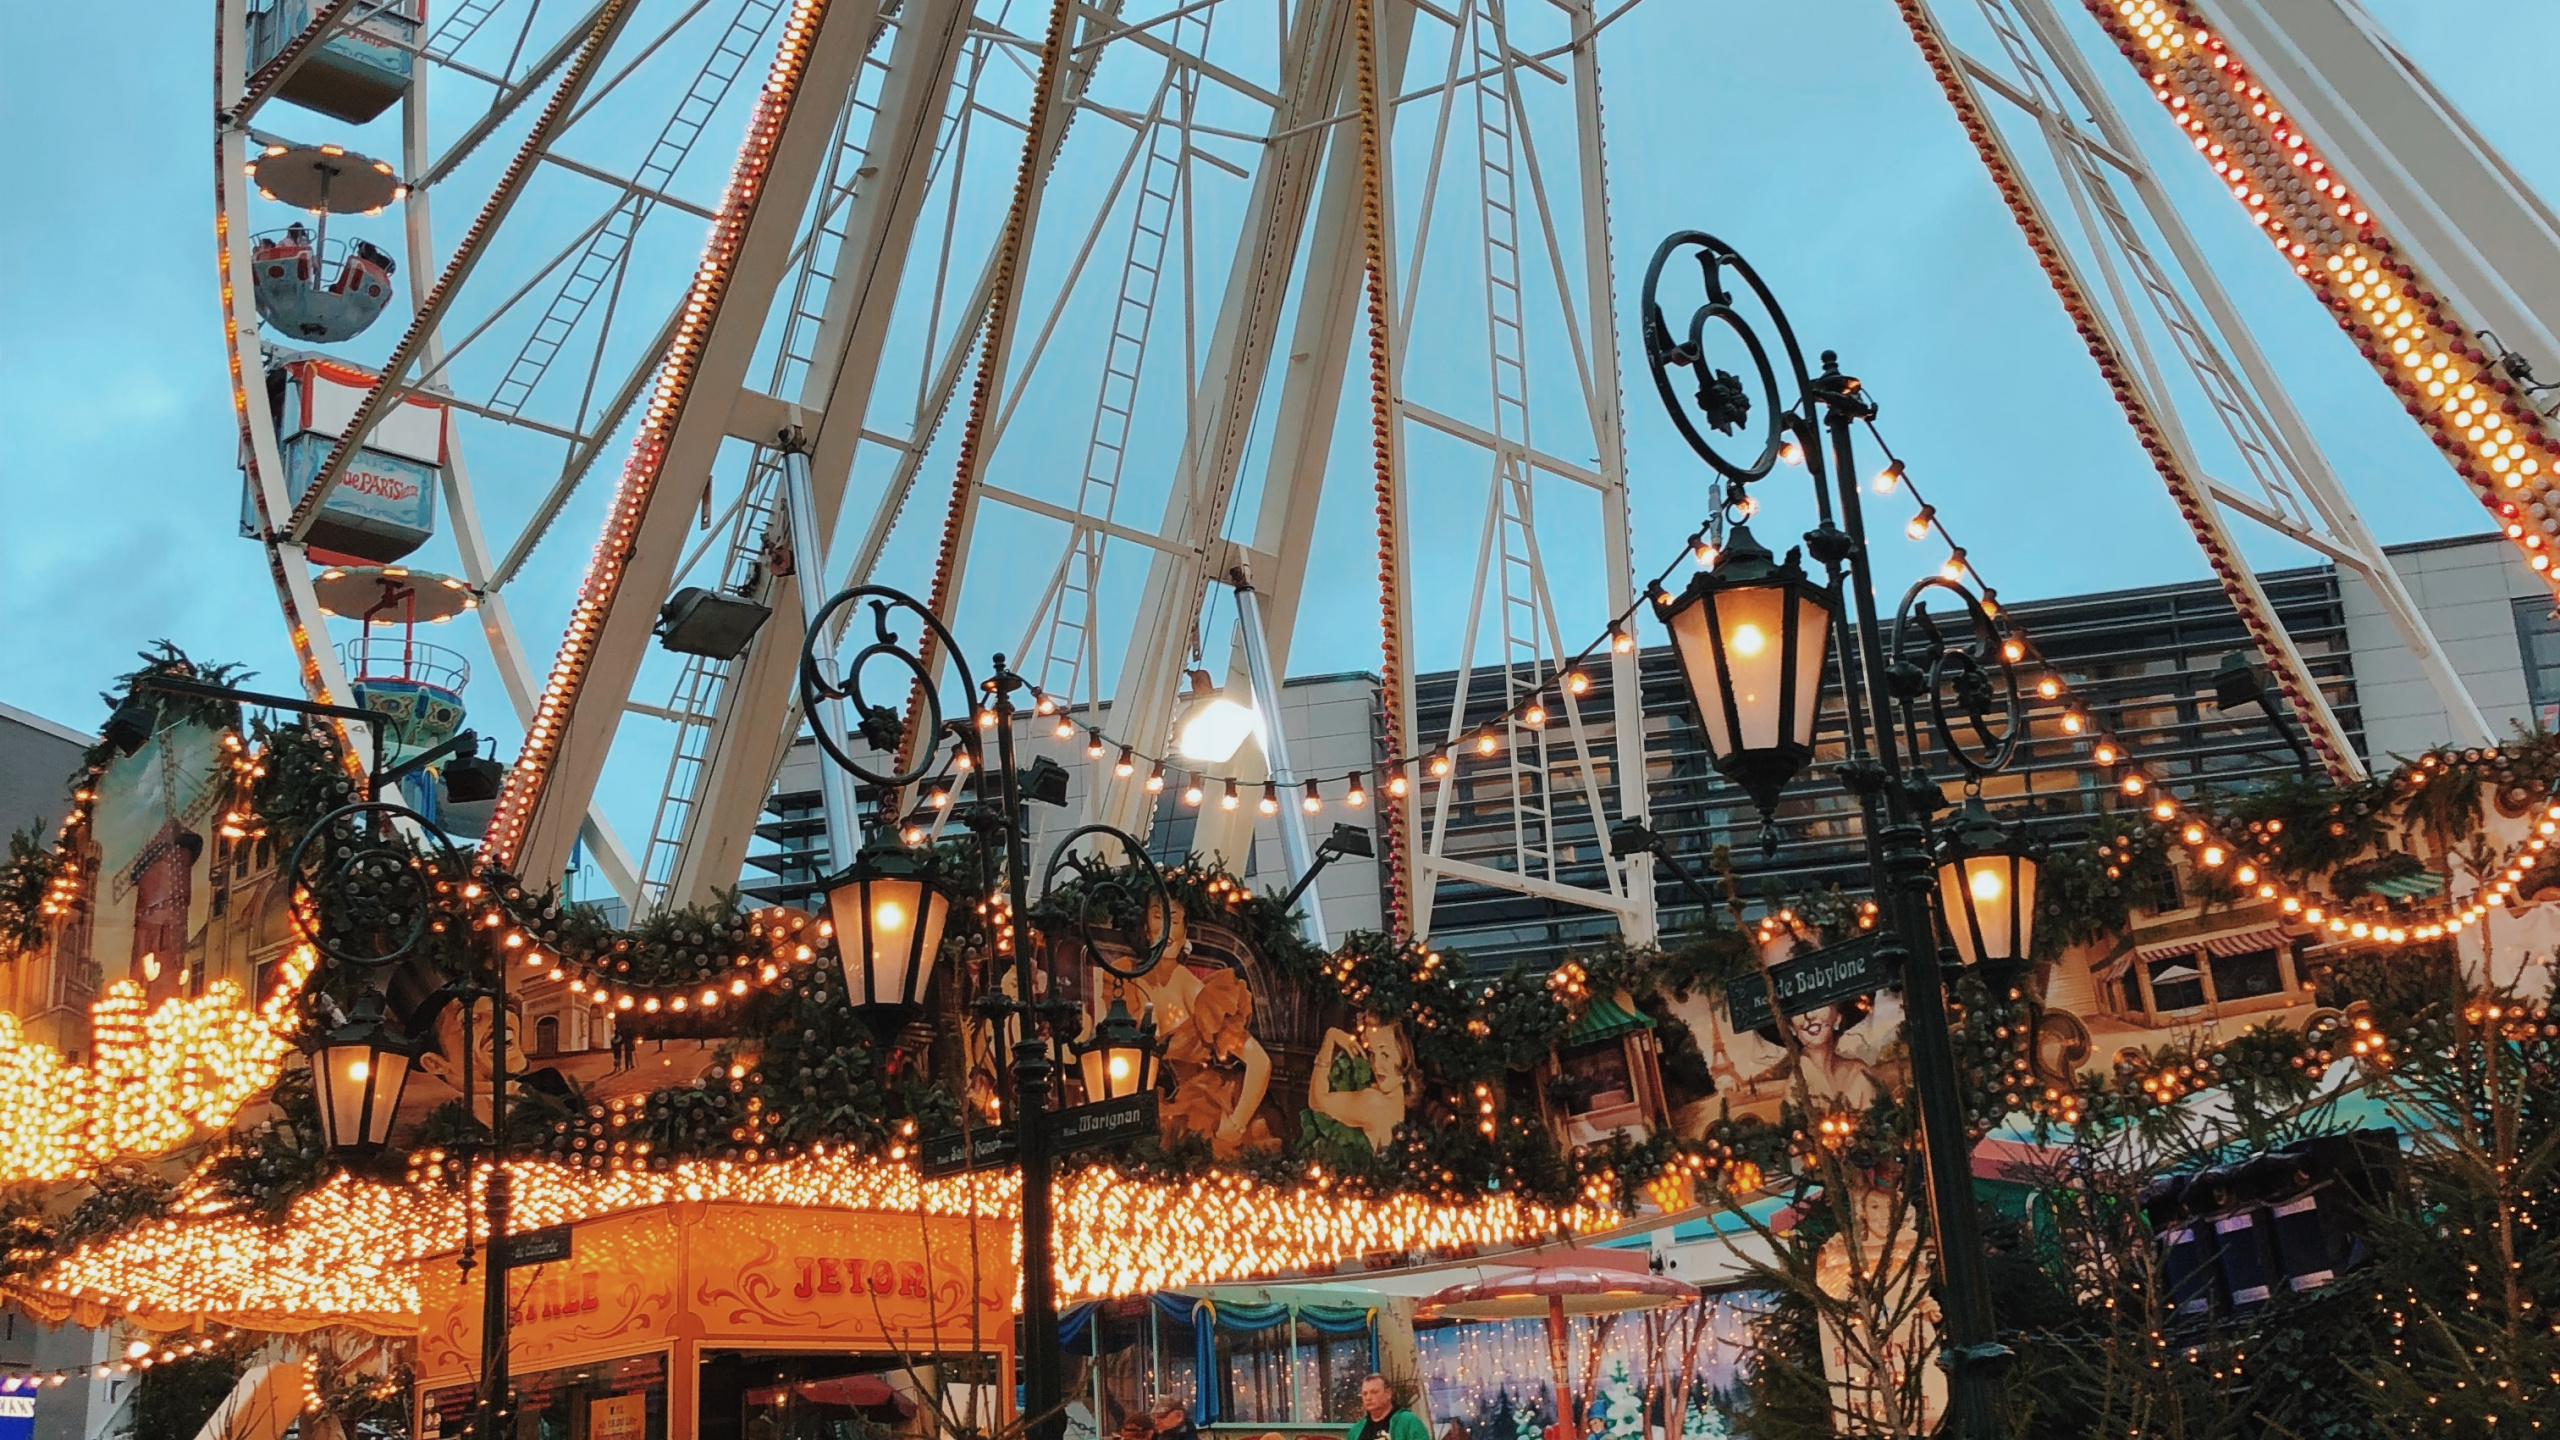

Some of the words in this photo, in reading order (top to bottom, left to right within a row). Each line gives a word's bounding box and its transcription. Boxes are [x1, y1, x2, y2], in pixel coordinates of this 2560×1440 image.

[1777, 978, 1793, 999] de
[1795, 957, 1866, 994] Babylone
[1079, 1109, 1140, 1132] Marignan
